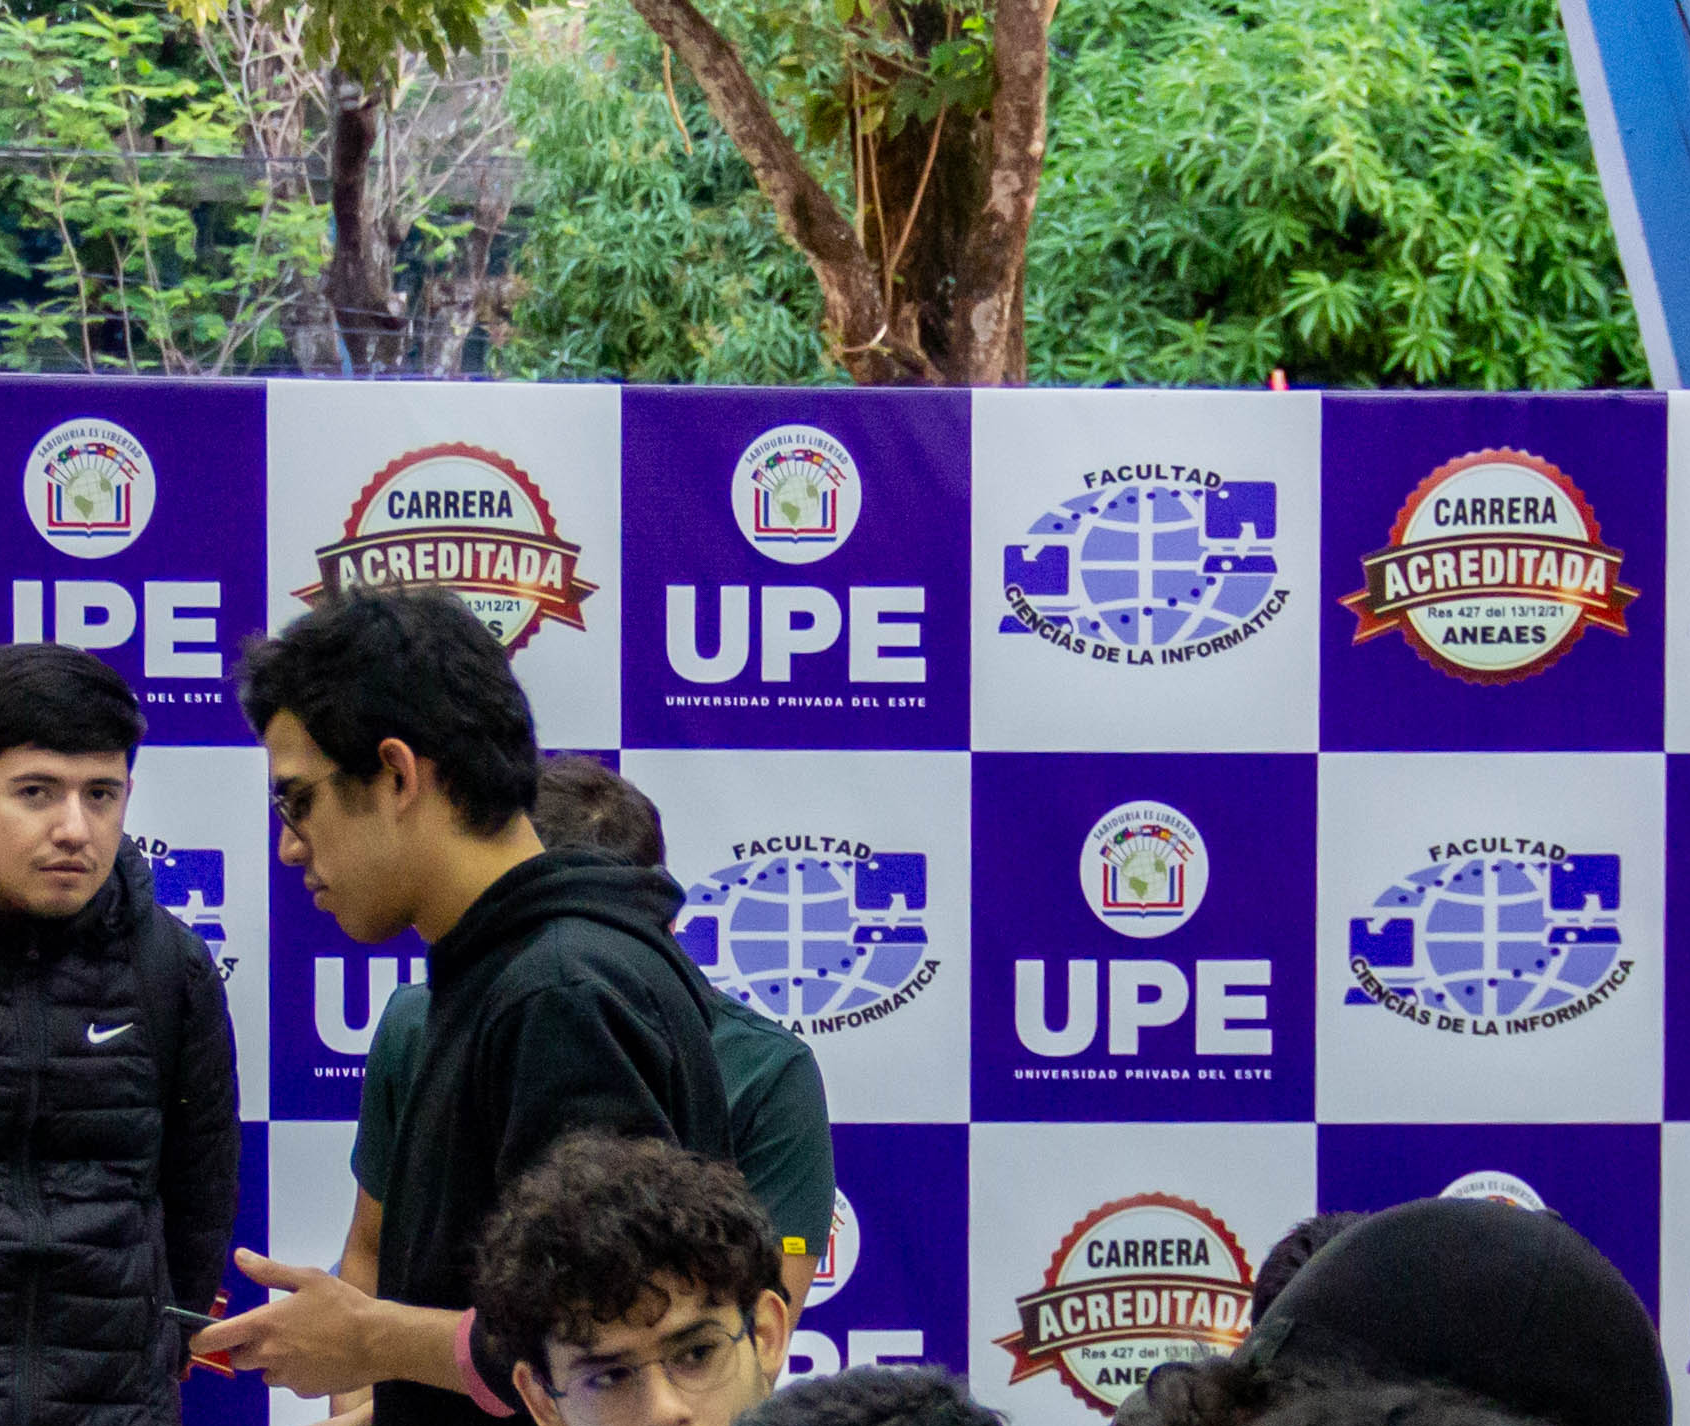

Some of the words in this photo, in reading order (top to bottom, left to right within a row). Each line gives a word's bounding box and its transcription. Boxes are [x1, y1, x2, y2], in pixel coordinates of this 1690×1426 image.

[102, 429, 143, 458] LIBERTAD
[809, 436, 849, 465] LIBERTAD
[1083, 464, 1222, 489] FACULTAD
[388, 490, 514, 519] CARRERA
[1434, 497, 1557, 526] CARRERA
[339, 542, 563, 593] ACREDITADA
[1385, 548, 1606, 601] ACREDITADA
[1005, 586, 1086, 655] CIENCIAS
[1091, 644, 1120, 663] DE
[1127, 650, 1154, 665] LA
[1162, 587, 1290, 665] INFORMATICA
[1428, 607, 1452, 618] Res
[1458, 606, 1480, 618] 427
[1485, 606, 1505, 618] del
[1511, 605, 1564, 618] 13/12/21
[666, 585, 926, 684] UPE
[1442, 625, 1546, 645] ANEAES
[147, 693, 176, 703] DEL
[184, 693, 222, 703] ESTE
[666, 696, 770, 706] UNIVERSIDAD
[778, 697, 843, 707] PRIVADA
[851, 697, 879, 707] DEL
[888, 697, 926, 707] ESTE
[732, 835, 871, 860] FACULTAD
[1429, 837, 1566, 862] FACULTAD
[811, 958, 941, 1034] INFORMATICA
[1015, 959, 1273, 1057] UPE
[1350, 958, 1432, 1026] CIENCIAS
[1437, 1015, 1465, 1033] DE
[1472, 1020, 1499, 1036] LA
[1506, 958, 1635, 1034] INFORMATICA
[1014, 1069, 1118, 1080] UNIVERSIDAD
[1125, 1069, 1190, 1079] PRIVADA
[1198, 1069, 1226, 1079] DEL
[1234, 1069, 1272, 1079] ESTE
[1087, 1238, 1210, 1268] CARRERA
[1111, 1347, 1134, 1358] 427
[1139, 1346, 1158, 1358] del
